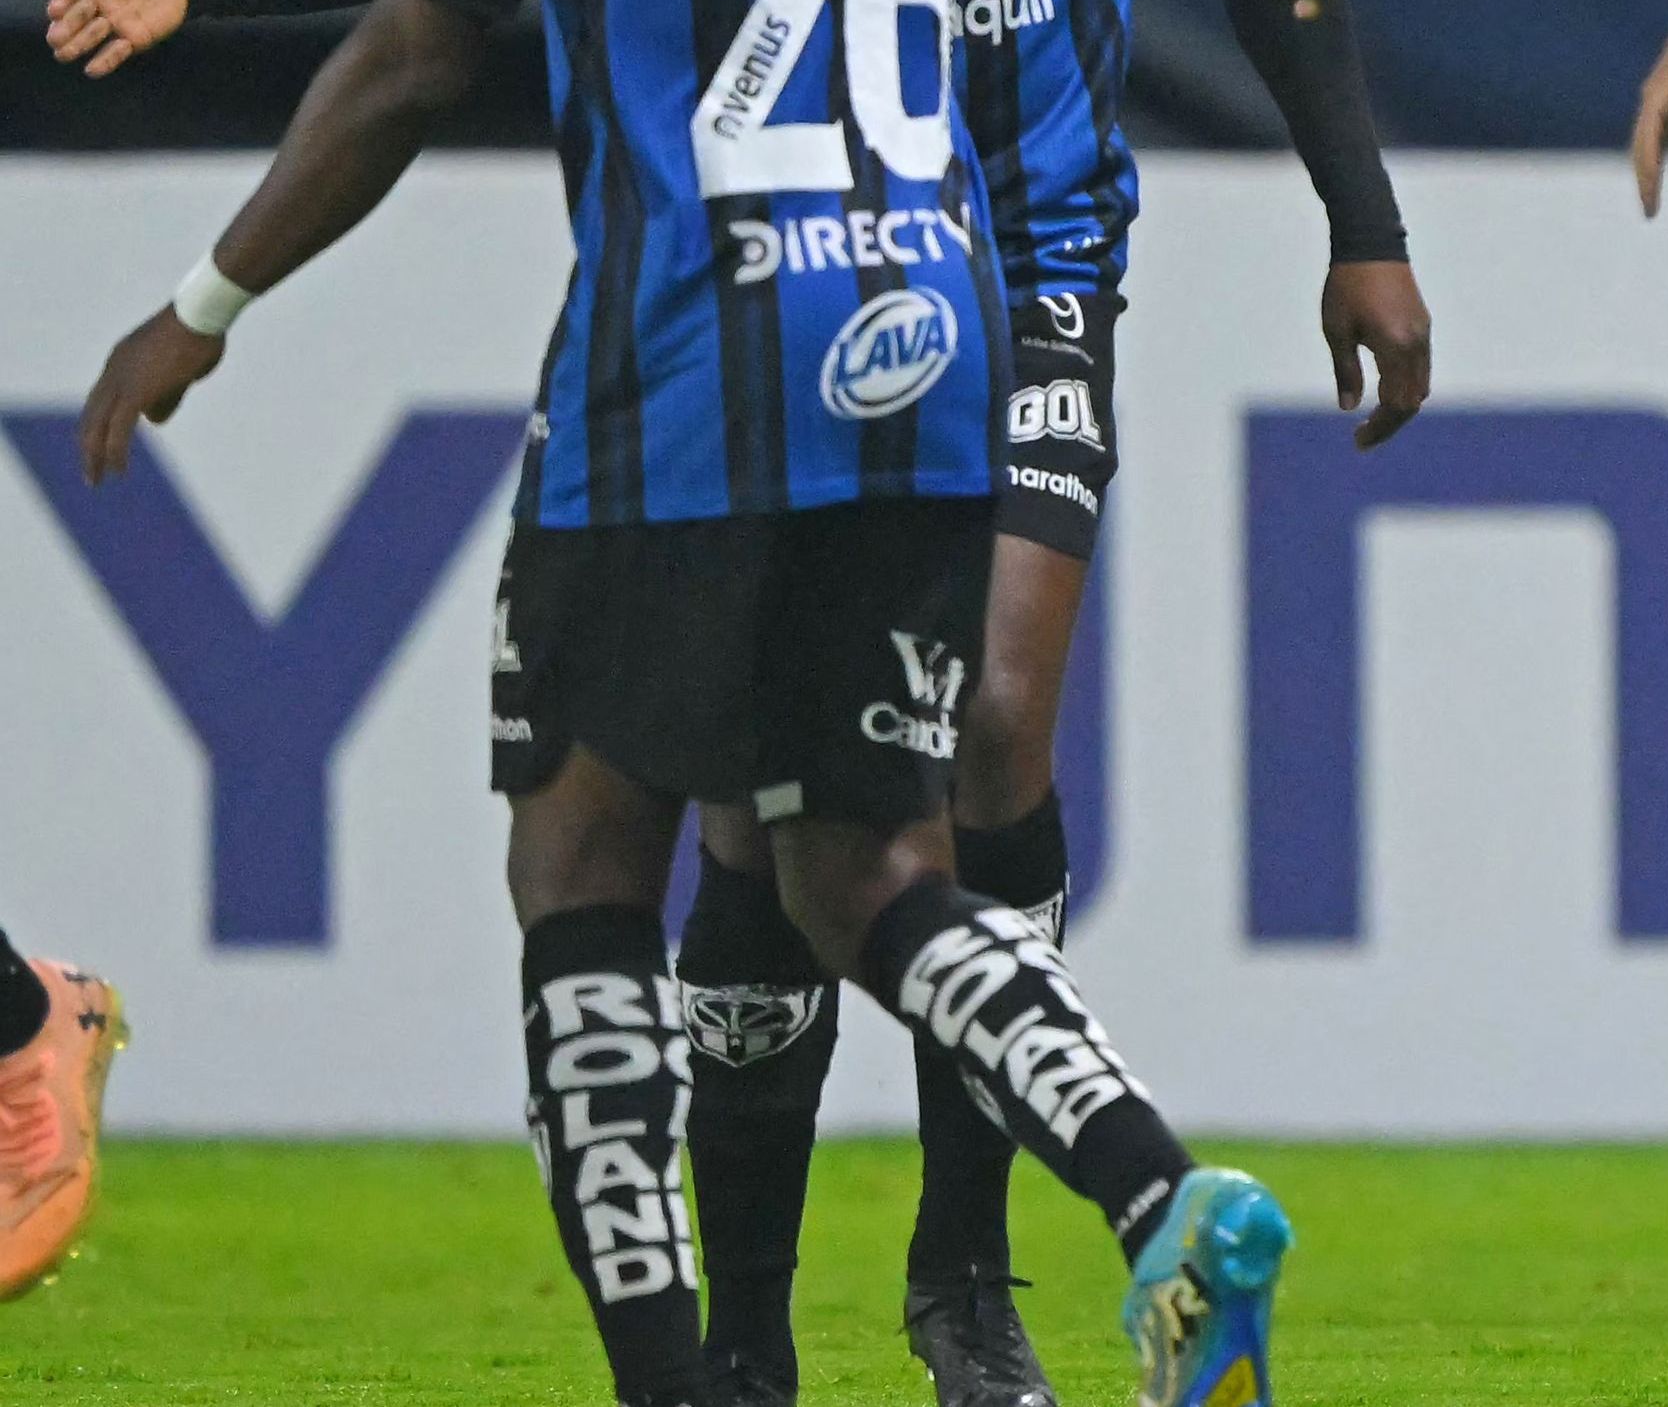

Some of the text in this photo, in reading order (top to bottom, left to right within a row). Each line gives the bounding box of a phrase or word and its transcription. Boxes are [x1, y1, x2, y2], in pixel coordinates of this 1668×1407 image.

[728, 203, 974, 285] DIRECTV
[833, 313, 949, 390] LAVA
[1007, 379, 1105, 452] GOL
[540, 971, 675, 1305] ROLAND
